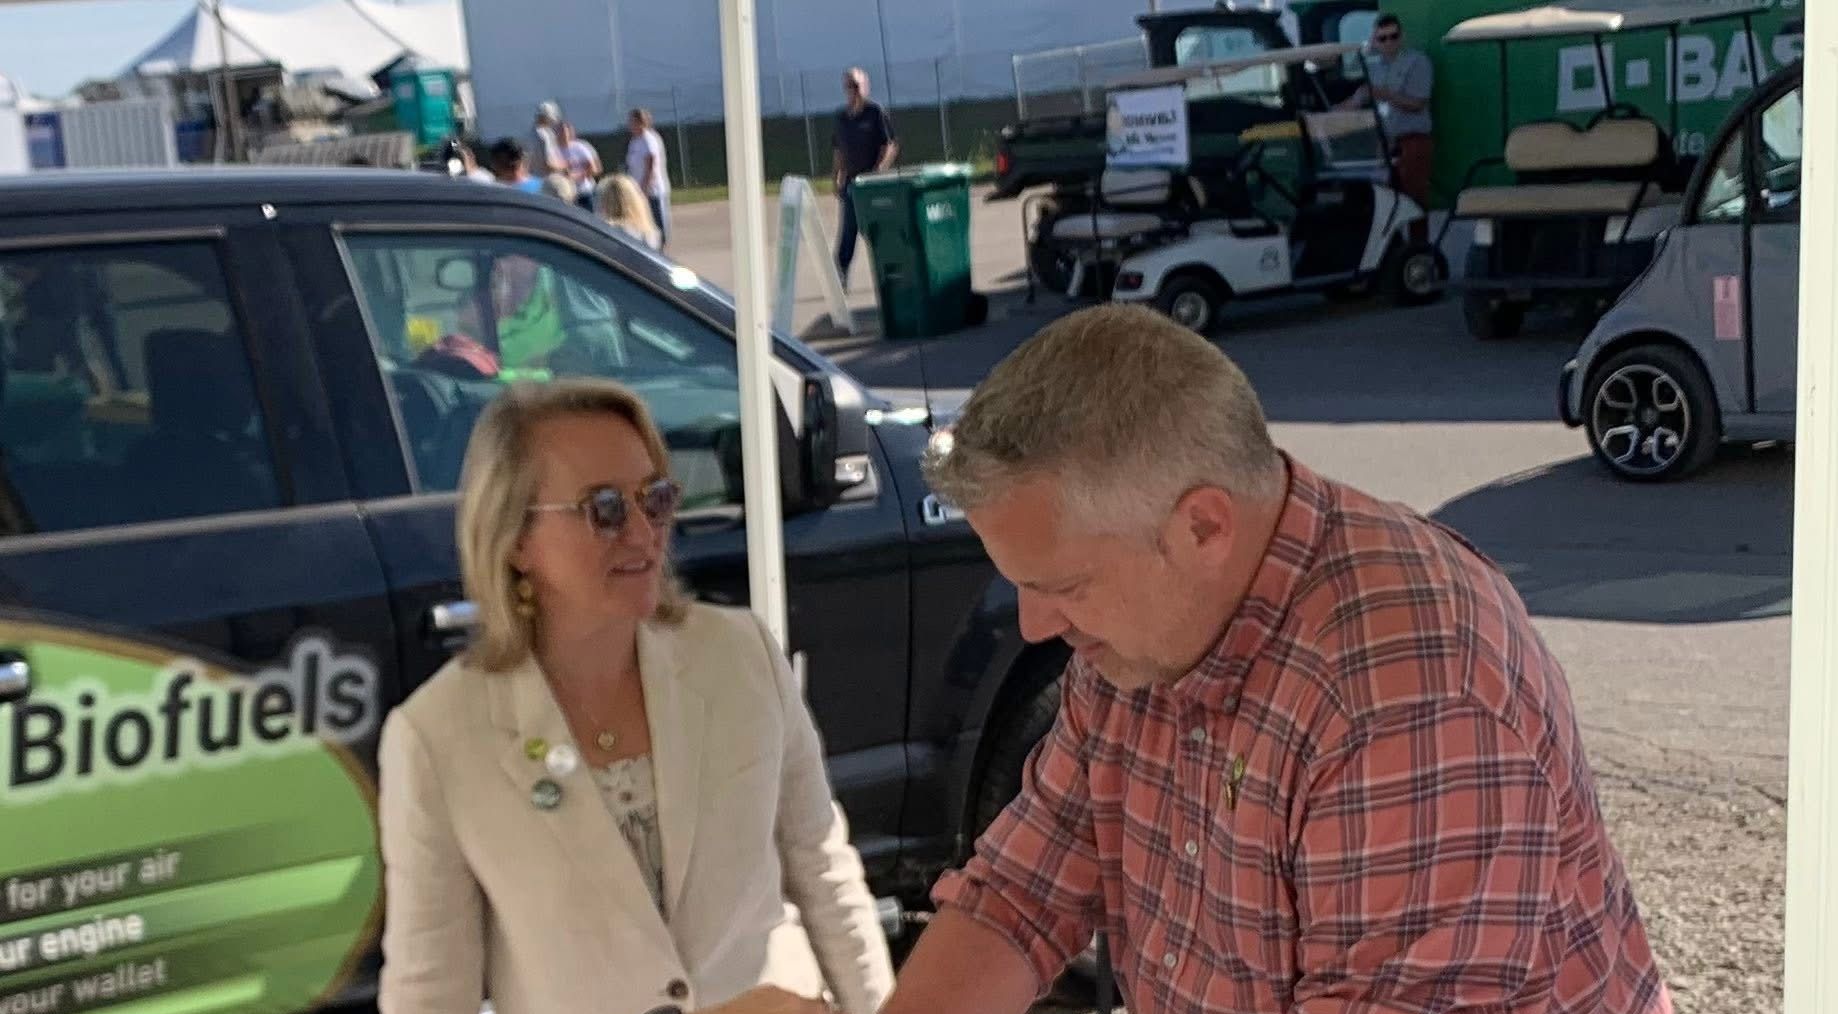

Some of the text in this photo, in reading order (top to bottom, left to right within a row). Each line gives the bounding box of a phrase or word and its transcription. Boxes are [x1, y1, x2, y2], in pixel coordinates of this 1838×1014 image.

[8, 650, 367, 787] Biofuels
[6, 849, 181, 912] for your air
[38, 914, 144, 960] engine
[71, 957, 168, 1001] wallet
